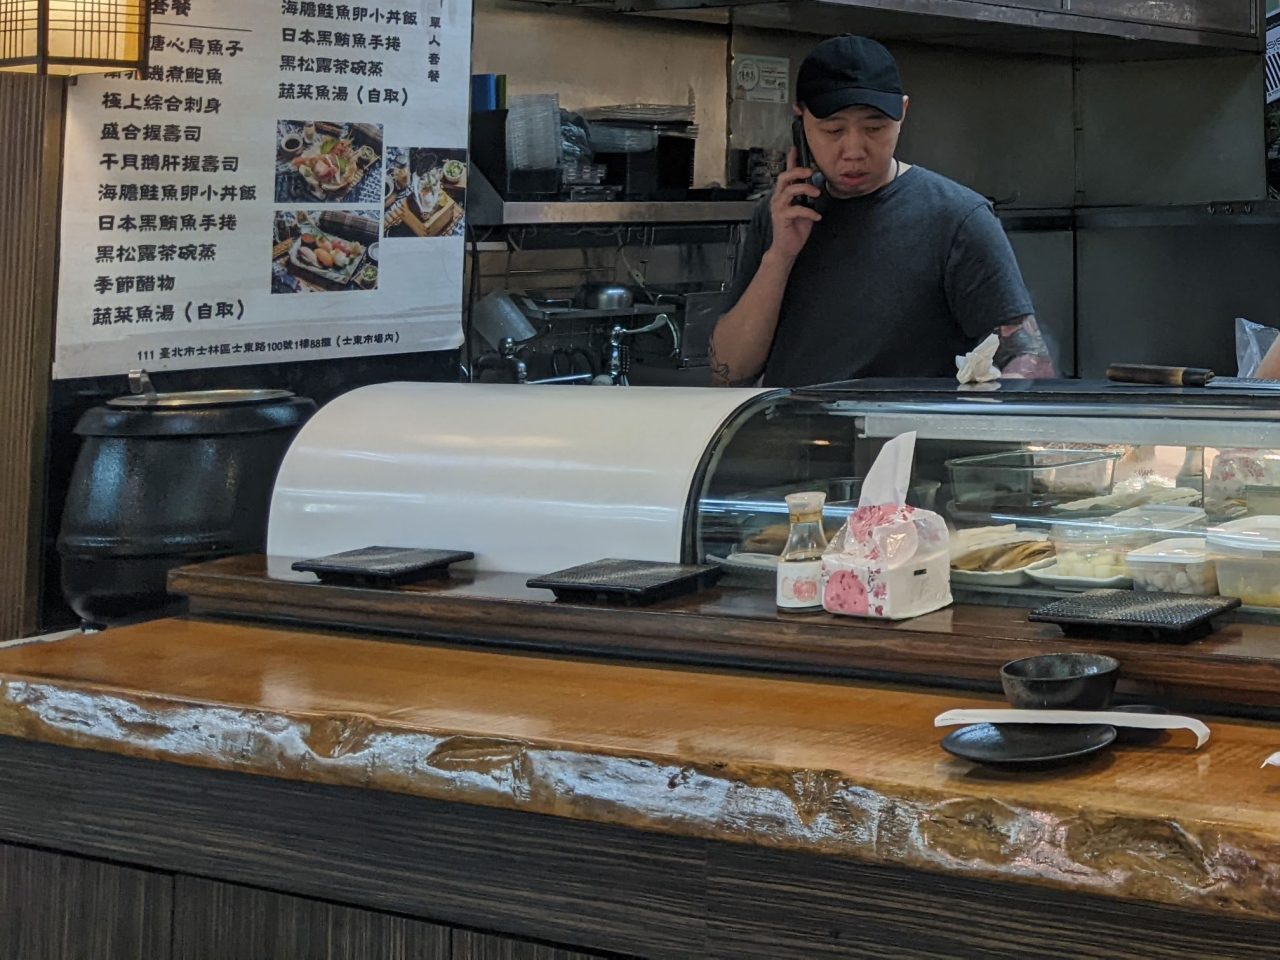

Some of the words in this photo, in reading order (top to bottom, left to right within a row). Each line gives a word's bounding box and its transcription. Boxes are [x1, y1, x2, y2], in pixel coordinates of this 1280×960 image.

[281, 0, 418, 26] 海膽鮭魚卵小丼飯
[281, 28, 401, 52] 日本黑鮪魚手捲
[428, 16, 441, 83] 單人套餐
[279, 55, 384, 78] 黑松露茶碗蒸
[102, 92, 222, 114] 極上綜合刺身
[100, 122, 202, 143] 盛合握壽司
[100, 153, 239, 173] 干貝鵝肝握壽司
[98, 183, 257, 202] 海膽鮭魚卵小丼飯
[98, 213, 237, 232] 日本黑鮪魚手捲
[95, 243, 217, 263] 黑松露茶碗蒸
[93, 274, 176, 294] 季節醋物
[137, 350, 154, 361] 111
